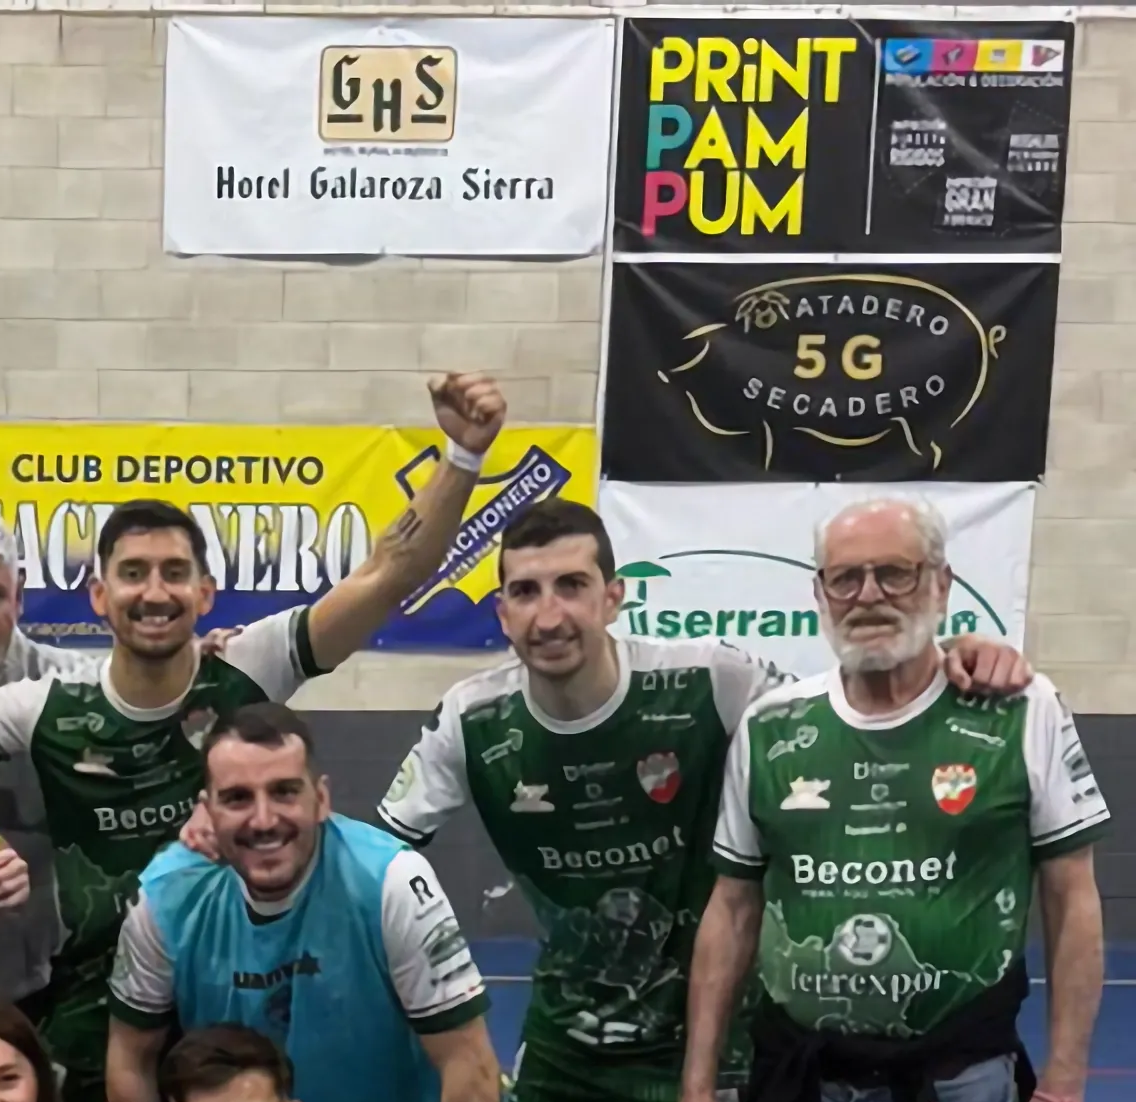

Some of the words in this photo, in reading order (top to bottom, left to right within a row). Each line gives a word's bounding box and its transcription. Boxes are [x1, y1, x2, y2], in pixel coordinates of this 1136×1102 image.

[645, 104, 808, 168] PAM
[310, 166, 442, 200] Galaroza
[462, 167, 554, 201] Sierra
[642, 169, 805, 236] PUM
[743, 374, 946, 418] SECADERO
[11, 453, 103, 484] CLUB
[116, 455, 325, 485] DEPORTIVO
[791, 849, 958, 885] Beconet
